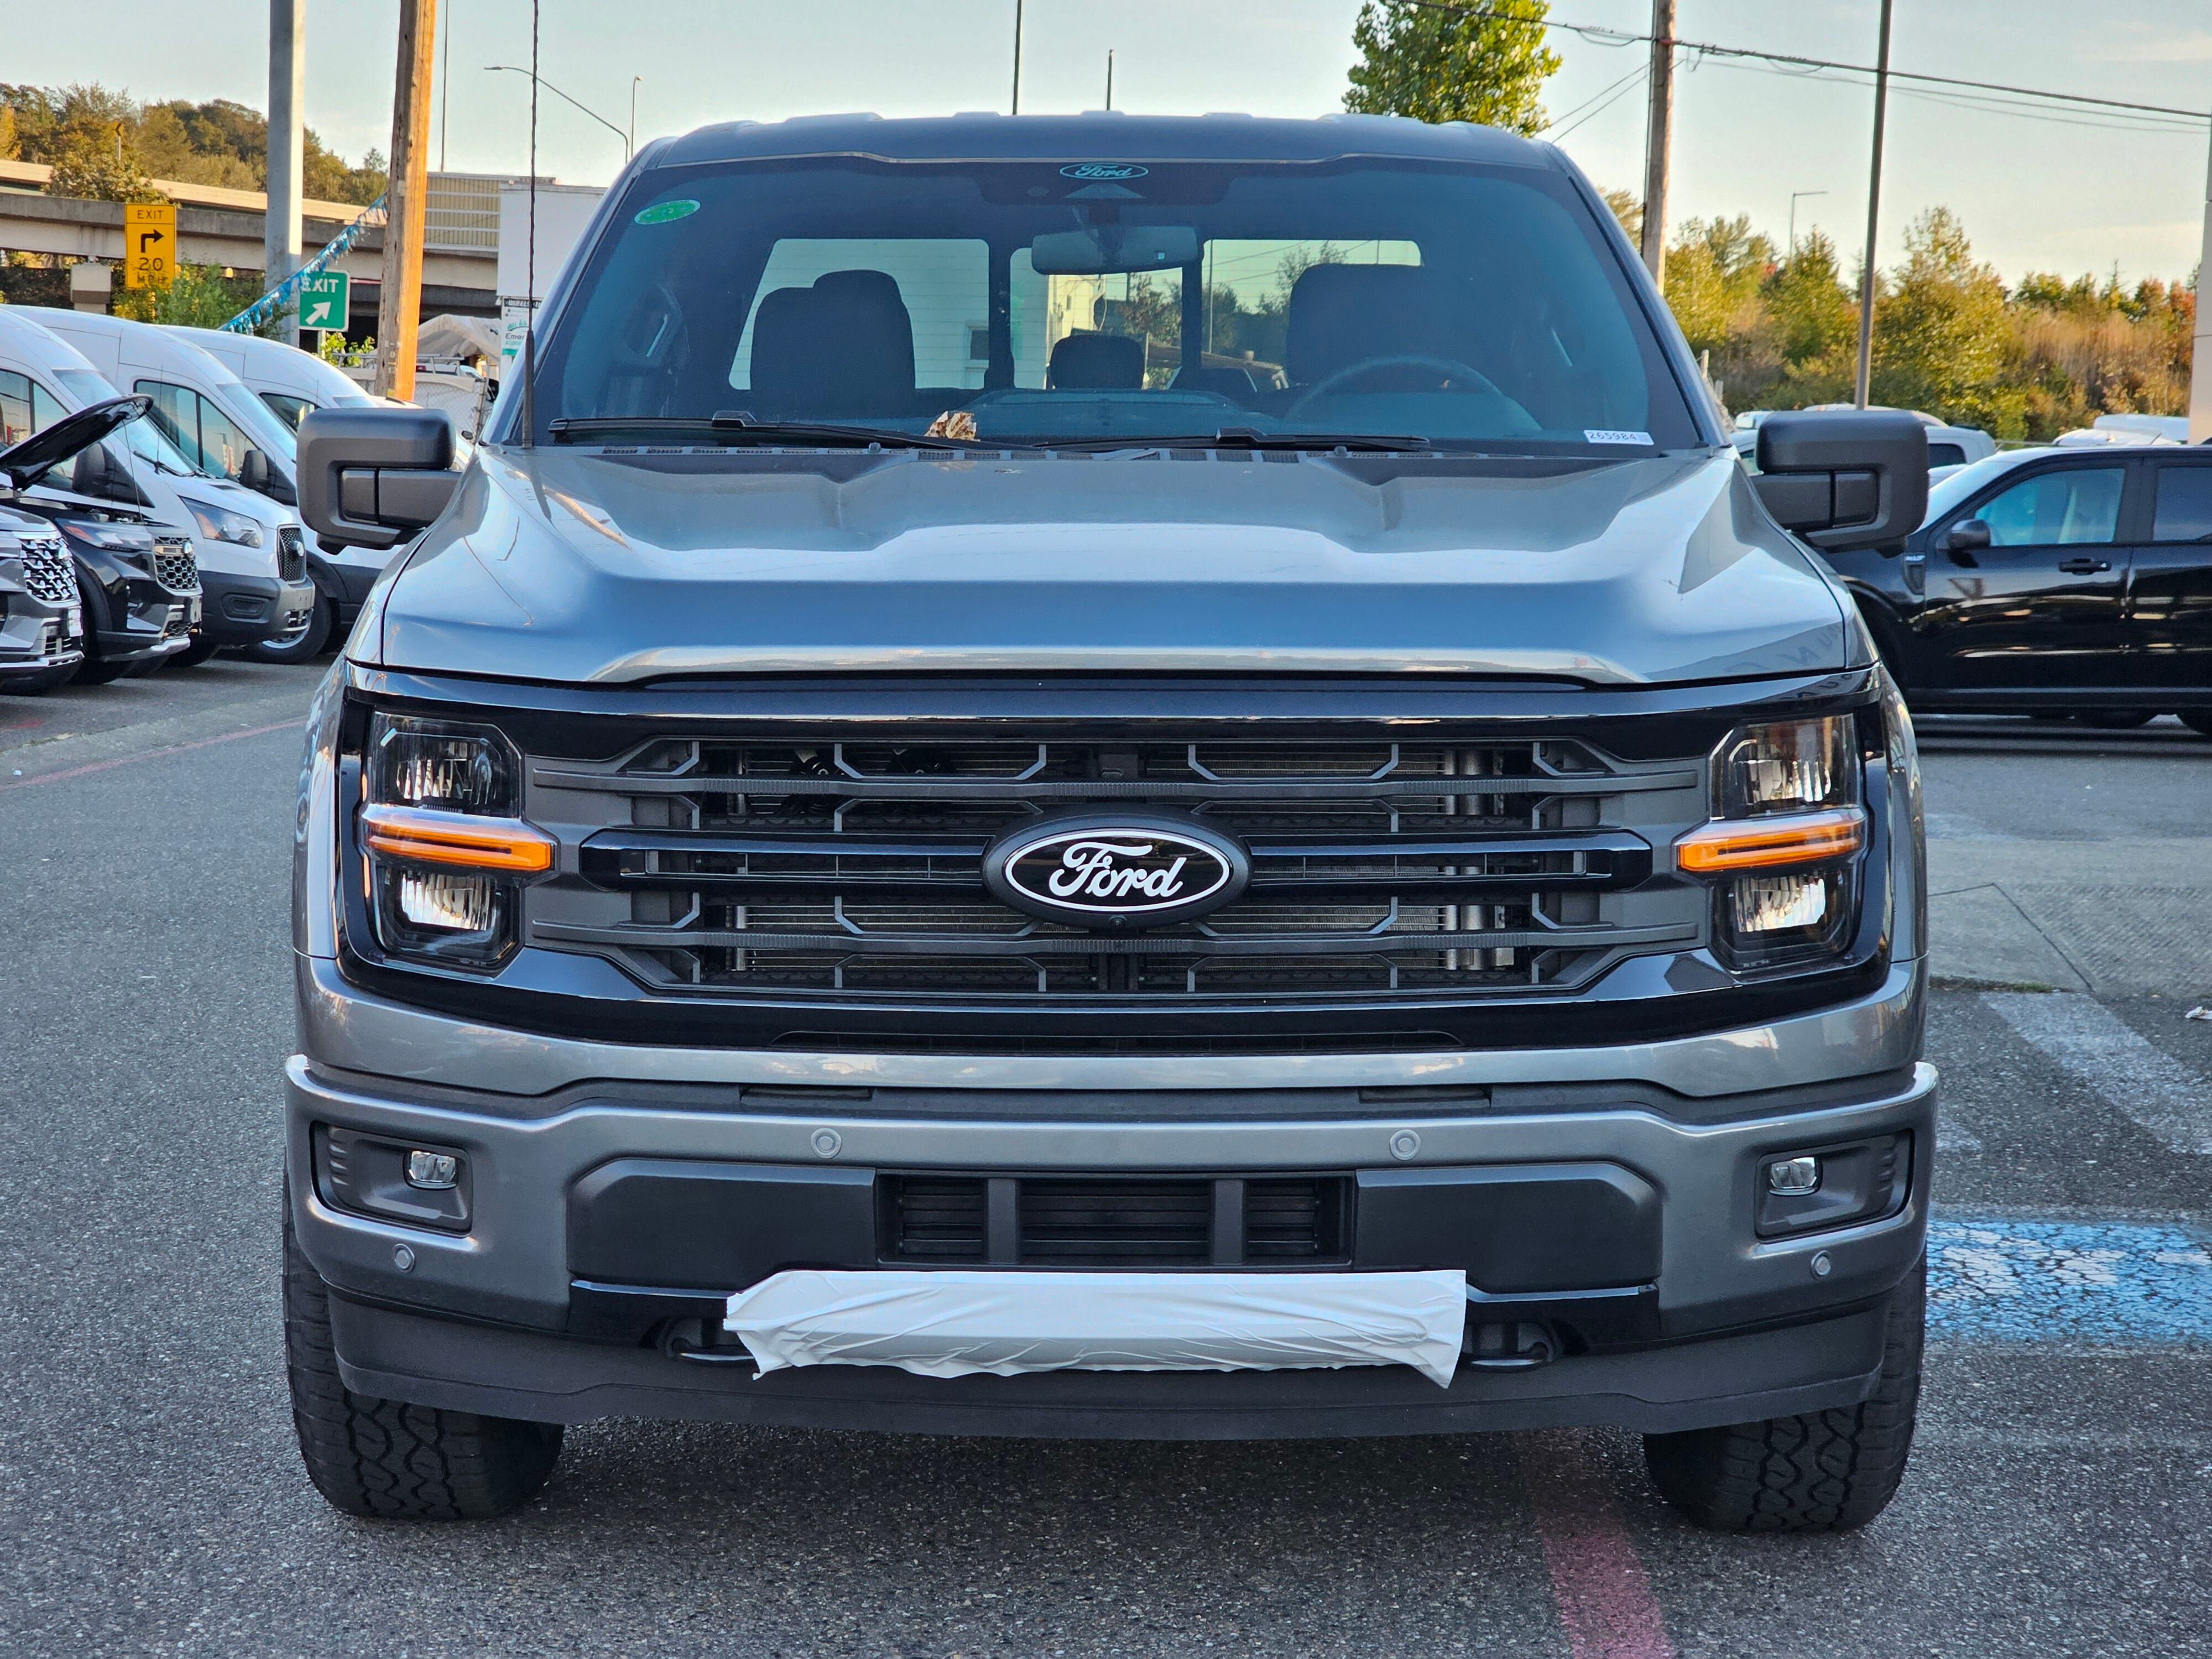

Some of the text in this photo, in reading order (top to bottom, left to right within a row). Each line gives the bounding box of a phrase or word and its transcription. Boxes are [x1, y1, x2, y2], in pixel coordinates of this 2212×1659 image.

[1074, 165, 1133, 177] Ford
[137, 210, 164, 219] EXIT
[139, 257, 163, 272] 20
[301, 276, 340, 293] EXIT
[1588, 431, 1637, 441] 265984
[1048, 842, 1187, 898] Ford
